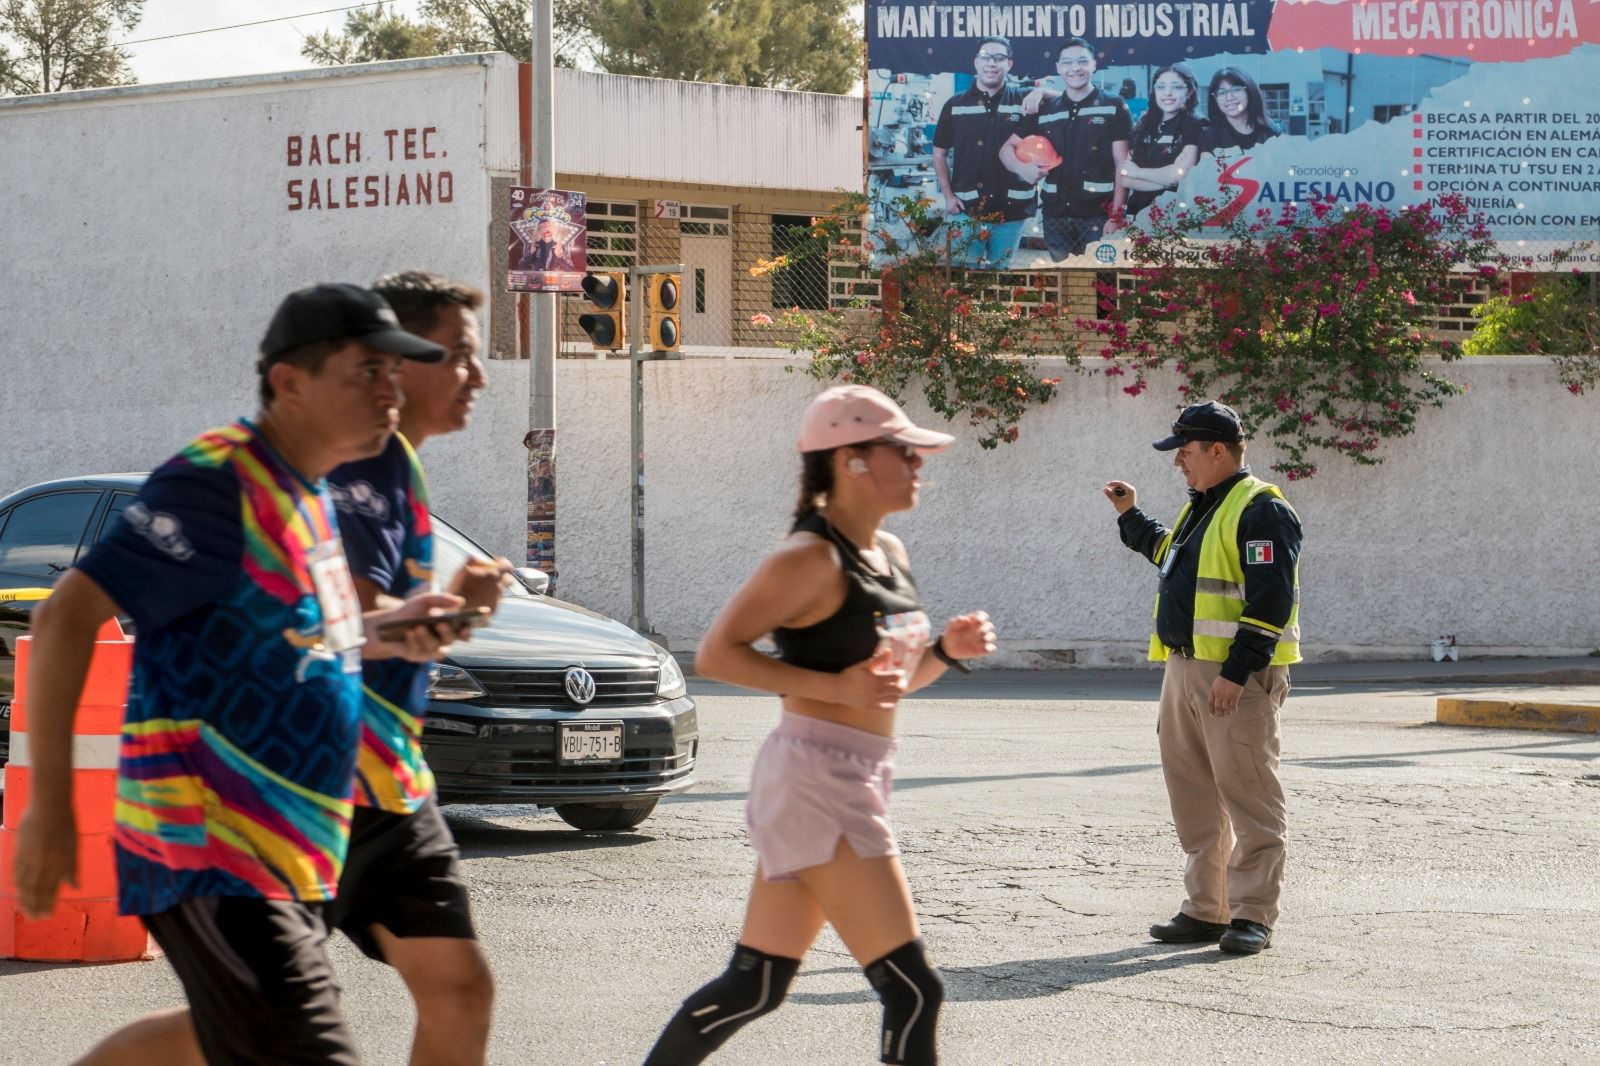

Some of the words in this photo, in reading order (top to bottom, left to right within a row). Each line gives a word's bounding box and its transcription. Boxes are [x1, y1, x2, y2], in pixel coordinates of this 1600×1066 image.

[876, 4, 1086, 39] MANTENIMIENTO
[1096, 2, 1255, 38] INDUSTRIAL
[1427, 113, 1477, 124] BECAS
[1480, 113, 1491, 124] A
[1495, 113, 1548, 124] PARTIR
[1552, 113, 1581, 124] DEL
[1427, 127, 1522, 141] FORMACIÓN
[1526, 130, 1547, 141] EN
[287, 131, 361, 167] BACH
[384, 126, 448, 162] TEC.
[1427, 144, 1547, 158] CERTIFICACIÓN
[1551, 147, 1572, 158] EN
[1427, 164, 1496, 175] TERMINA
[1500, 164, 1521, 175] TU
[1527, 164, 1557, 175] TSU
[1562, 164, 1583, 175] EN
[1587, 164, 1595, 175] 2
[287, 171, 453, 211] SALESIANO
[1427, 178, 1489, 192] OPCIÓN
[1492, 181, 1504, 192] A
[1541, 215, 1575, 226] CON
[563, 736, 621, 753] VBU-751-B
